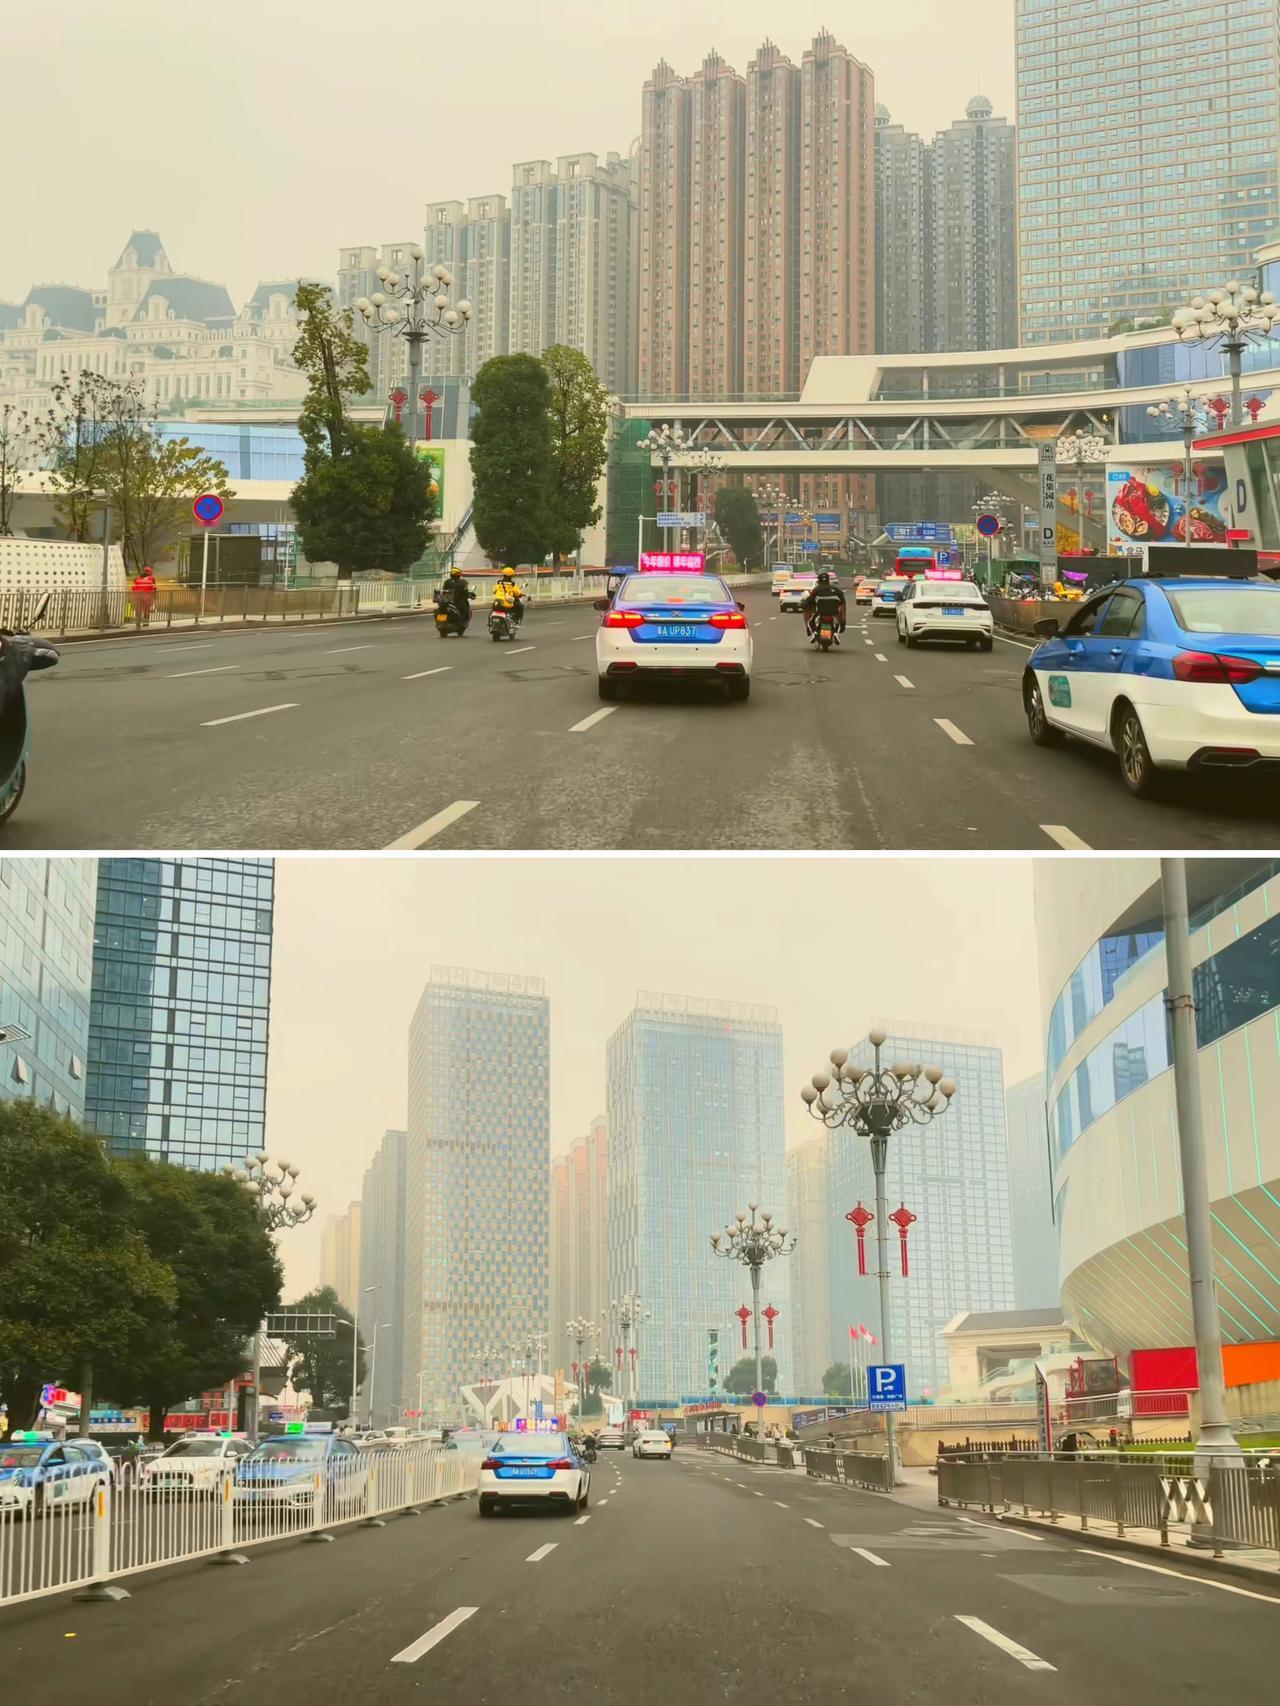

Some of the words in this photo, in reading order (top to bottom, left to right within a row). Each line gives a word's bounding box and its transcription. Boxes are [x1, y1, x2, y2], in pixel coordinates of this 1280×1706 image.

[1236, 479, 1247, 513] D
[1043, 528, 1053, 539] D
[940, 552, 947, 561] P
[876, 1368, 896, 1392] P
